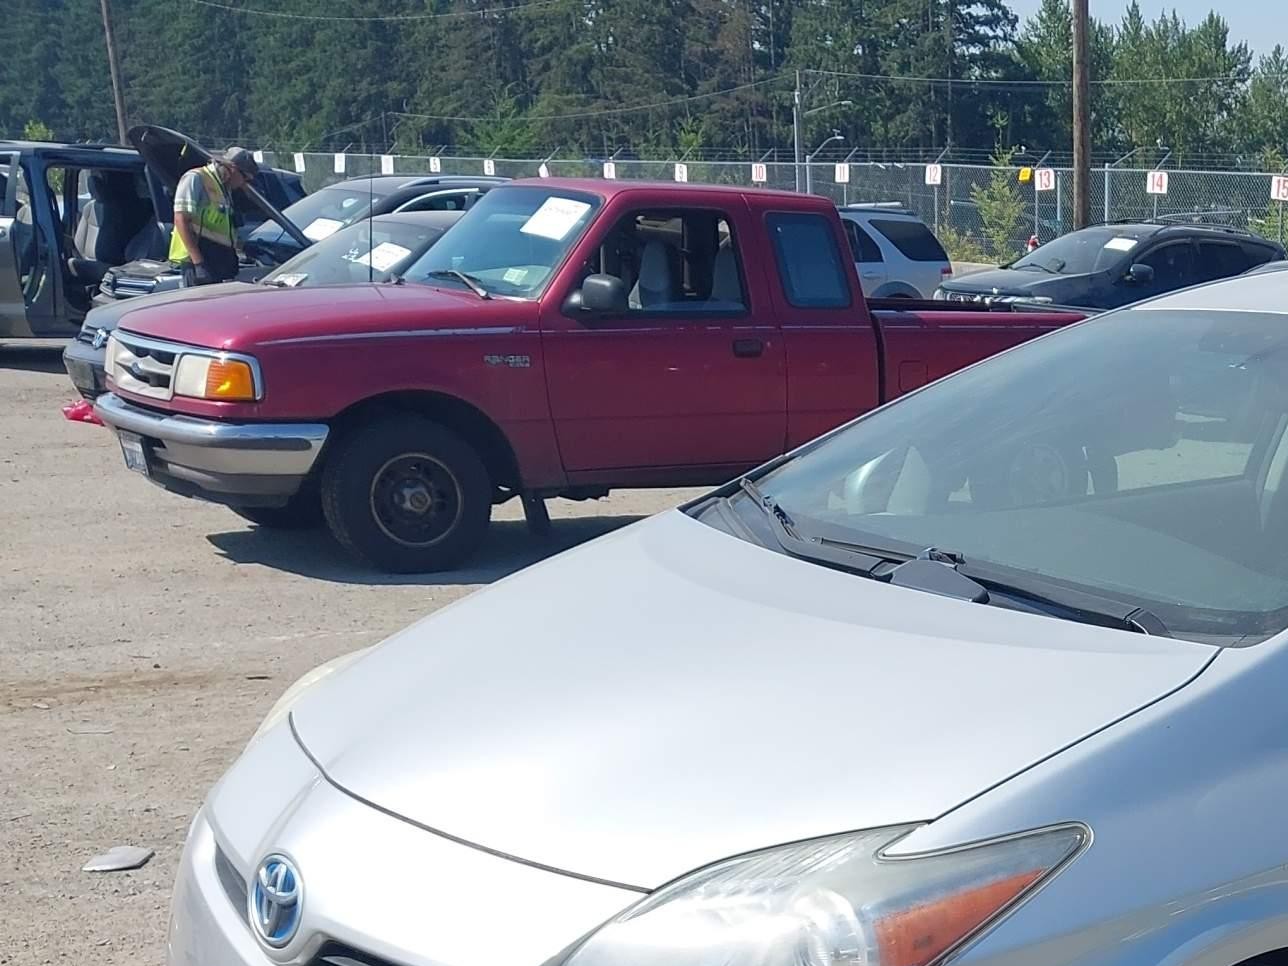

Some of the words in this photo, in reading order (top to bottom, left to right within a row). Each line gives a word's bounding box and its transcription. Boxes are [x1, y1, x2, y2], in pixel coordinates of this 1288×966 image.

[755, 165, 764, 181] 10
[838, 165, 846, 181] 11
[929, 166, 938, 183] 12
[1039, 170, 1051, 189] 13
[1151, 174, 1164, 191] 14
